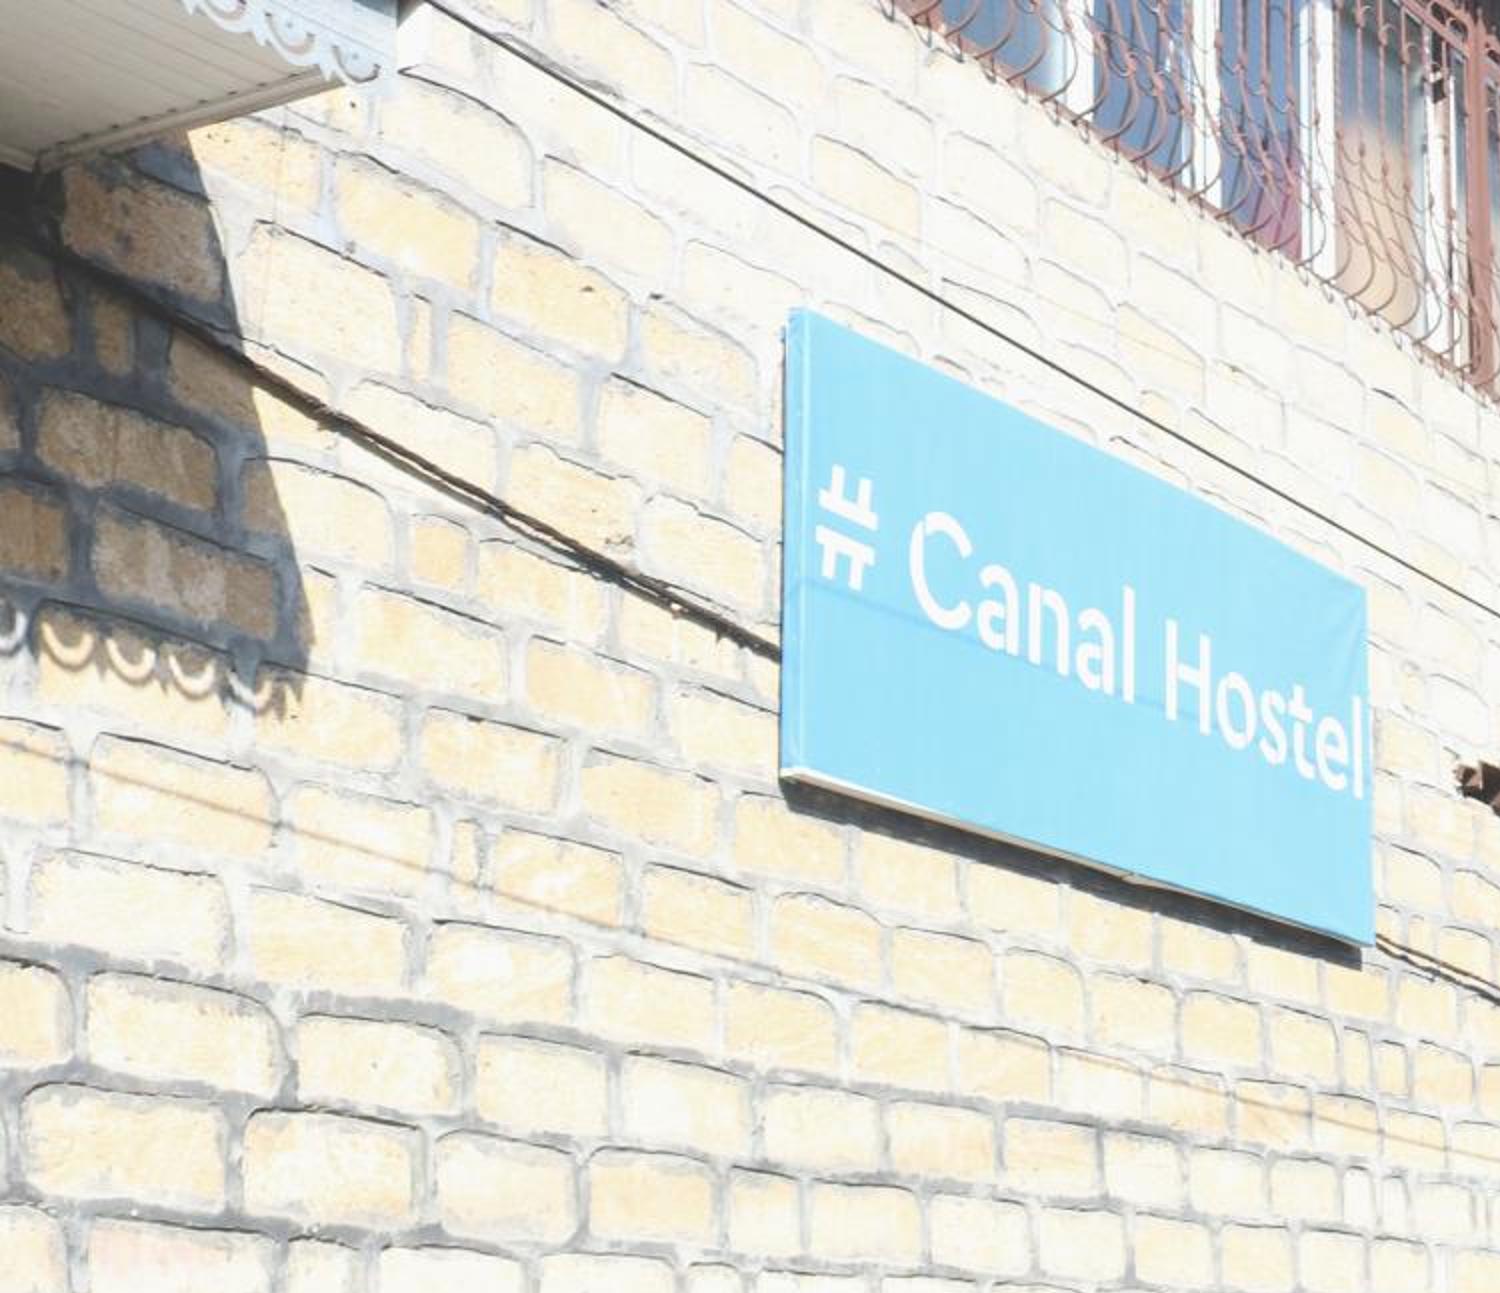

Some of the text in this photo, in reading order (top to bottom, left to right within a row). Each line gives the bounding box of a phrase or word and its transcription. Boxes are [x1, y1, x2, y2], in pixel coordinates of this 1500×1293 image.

[815, 464, 1365, 800] # Canal Hostel
